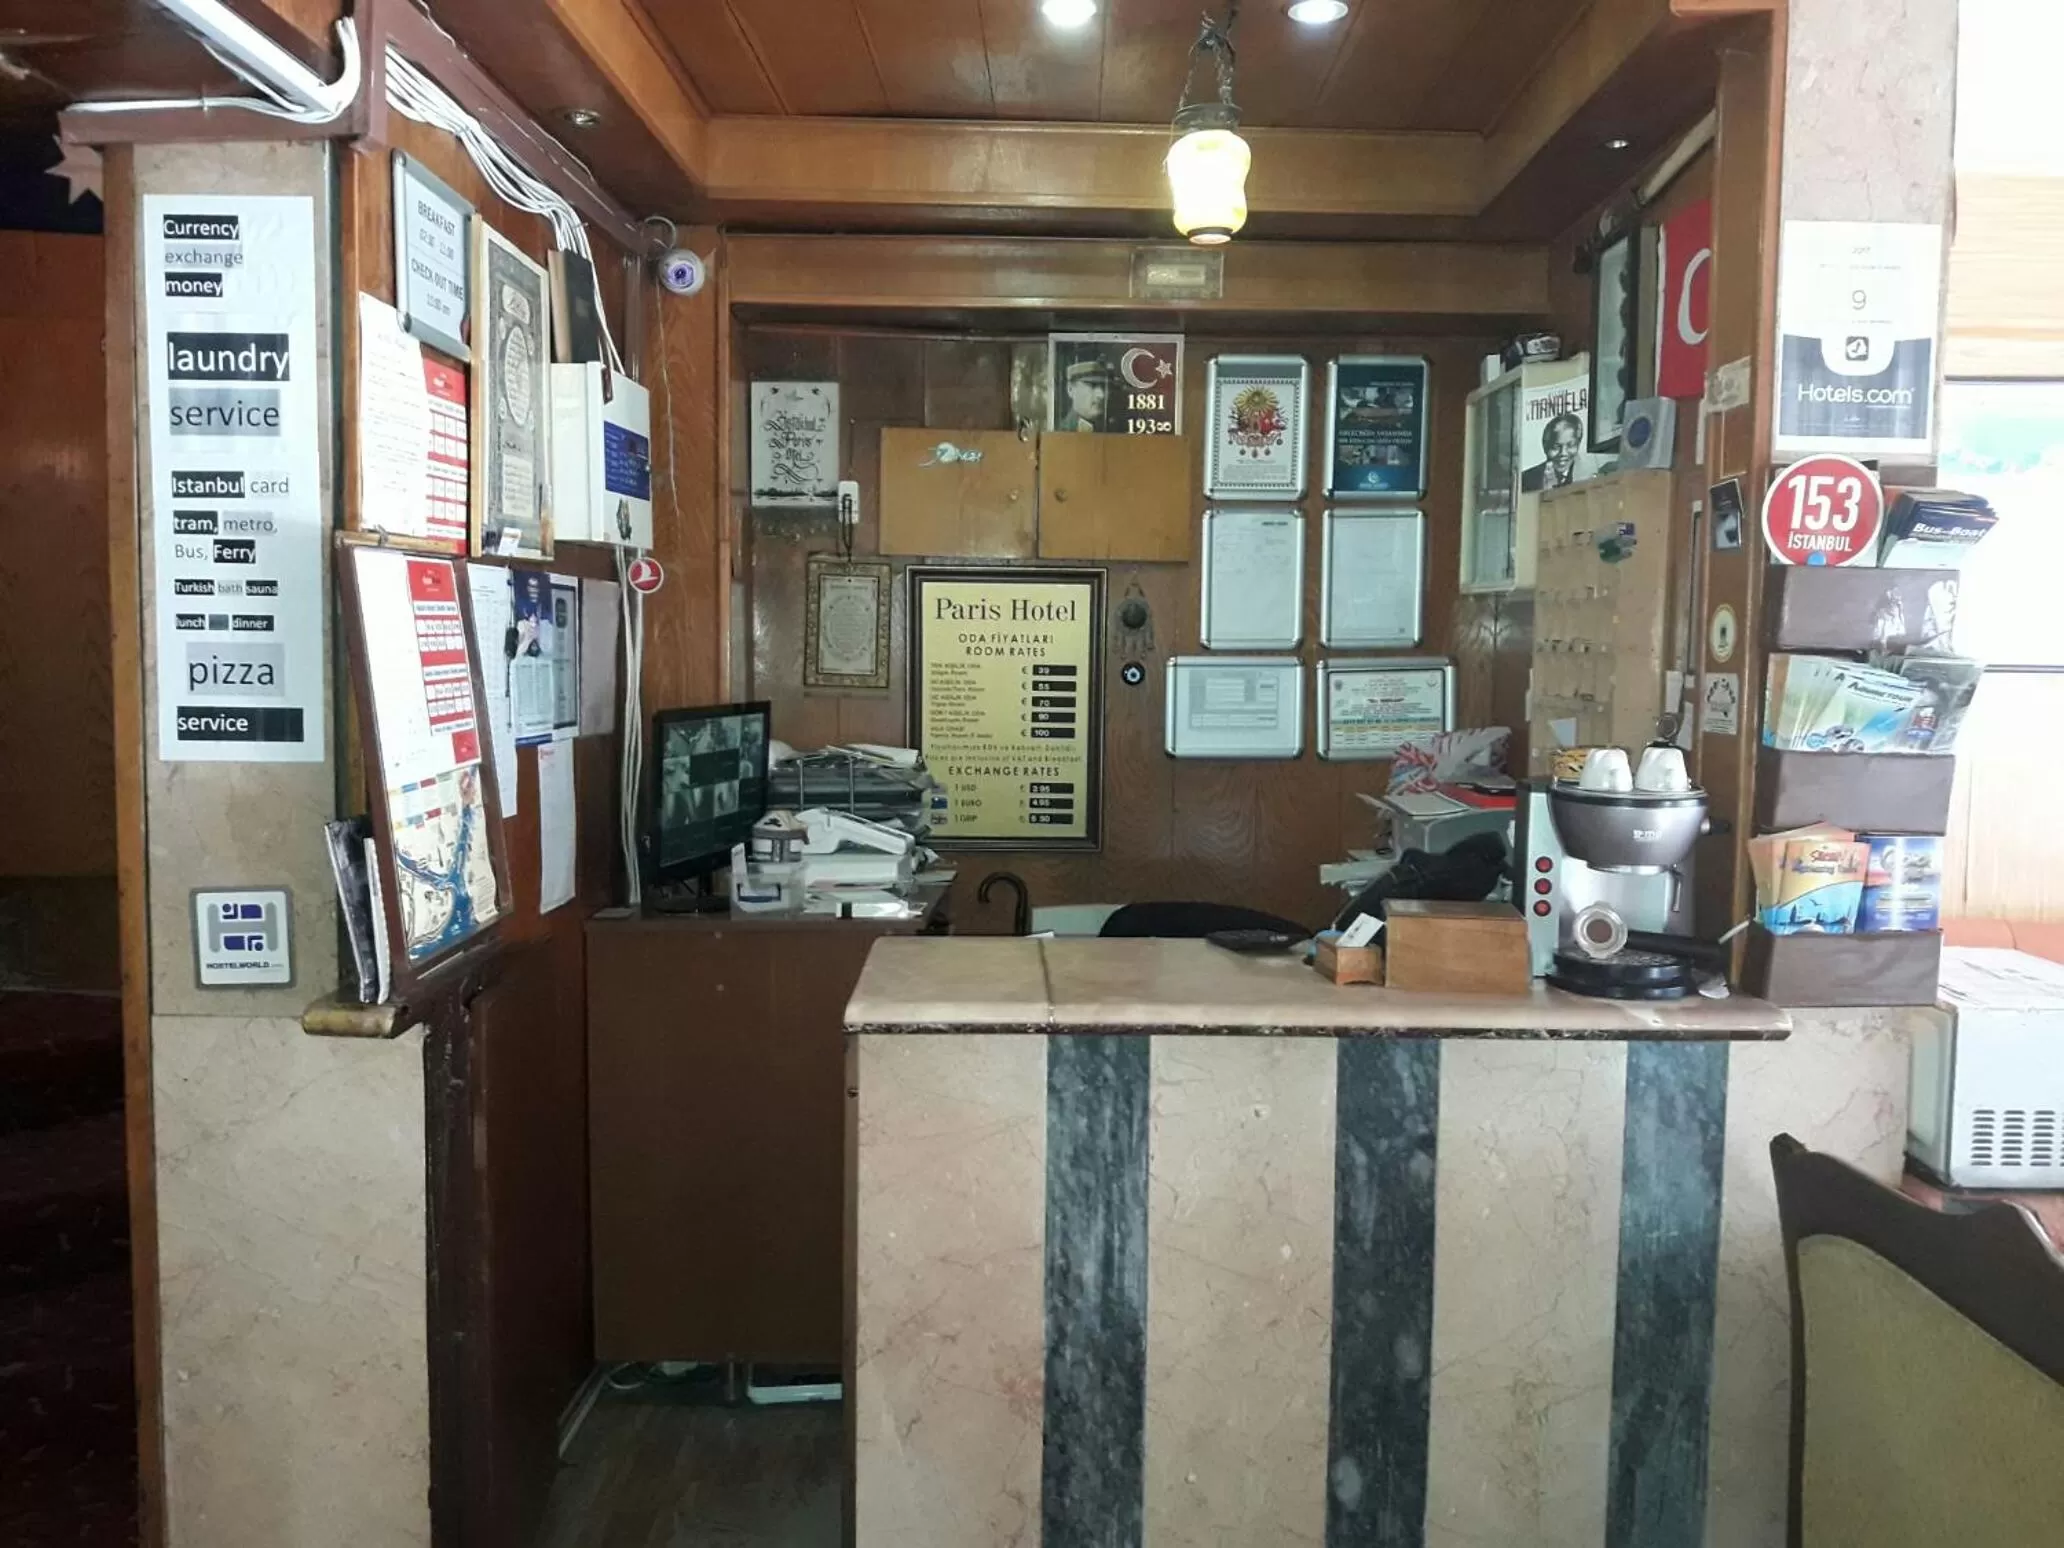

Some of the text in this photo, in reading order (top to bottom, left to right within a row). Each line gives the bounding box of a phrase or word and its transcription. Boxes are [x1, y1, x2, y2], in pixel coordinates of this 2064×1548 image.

[417, 199, 456, 237] BREAKFAST
[163, 219, 240, 239] Currency
[164, 247, 244, 268] exchange
[165, 278, 224, 297] money
[411, 257, 465, 301] CHECK OUT TIME
[1851, 289, 1867, 310] 9
[167, 341, 290, 380] laundry
[1128, 394, 1165, 410] 1881
[1526, 387, 1588, 421] MANDELA
[1798, 383, 1913, 405] Hotels.com
[170, 399, 281, 428] service
[171, 475, 290, 494] Istanbul card
[1787, 474, 1863, 532] 153
[174, 515, 219, 534] tram,
[1788, 531, 1853, 552] İSTANBUL
[175, 544, 256, 563] Bus, Ferry
[174, 581, 279, 594] Turkish bath sauna
[936, 597, 1076, 621] Paris Hotel
[175, 615, 268, 629] lunch dinner
[958, 631, 1055, 645] ODA FİYATLARI
[966, 646, 1047, 657] ROOM RATES
[189, 654, 275, 691] pizza
[177, 714, 249, 732] service
[948, 766, 1060, 777] EXCHANGE RATES
